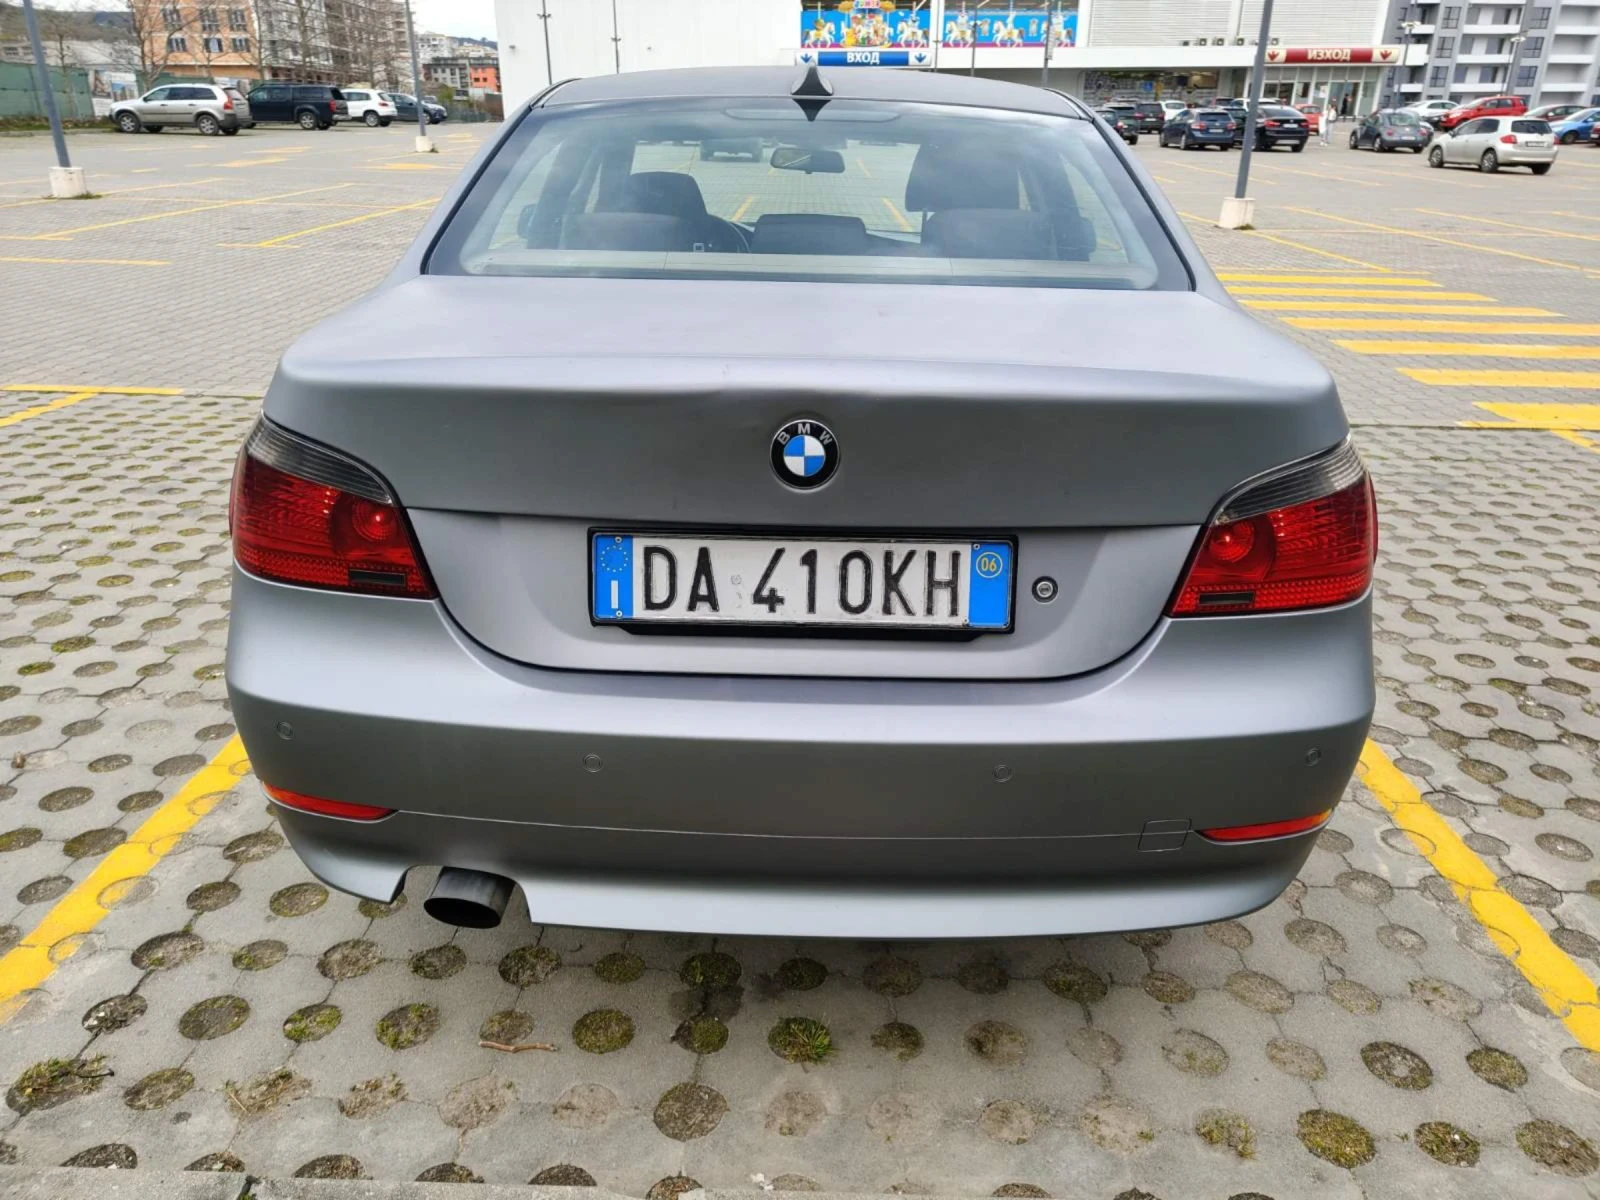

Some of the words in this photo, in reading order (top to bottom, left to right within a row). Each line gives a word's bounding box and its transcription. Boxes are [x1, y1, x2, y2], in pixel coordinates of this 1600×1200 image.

[847, 51, 880, 65] ВХОД
[1307, 48, 1352, 62] ИЗХОД
[777, 423, 833, 445] BMW
[980, 557, 997, 573] 06
[643, 546, 720, 612] DA
